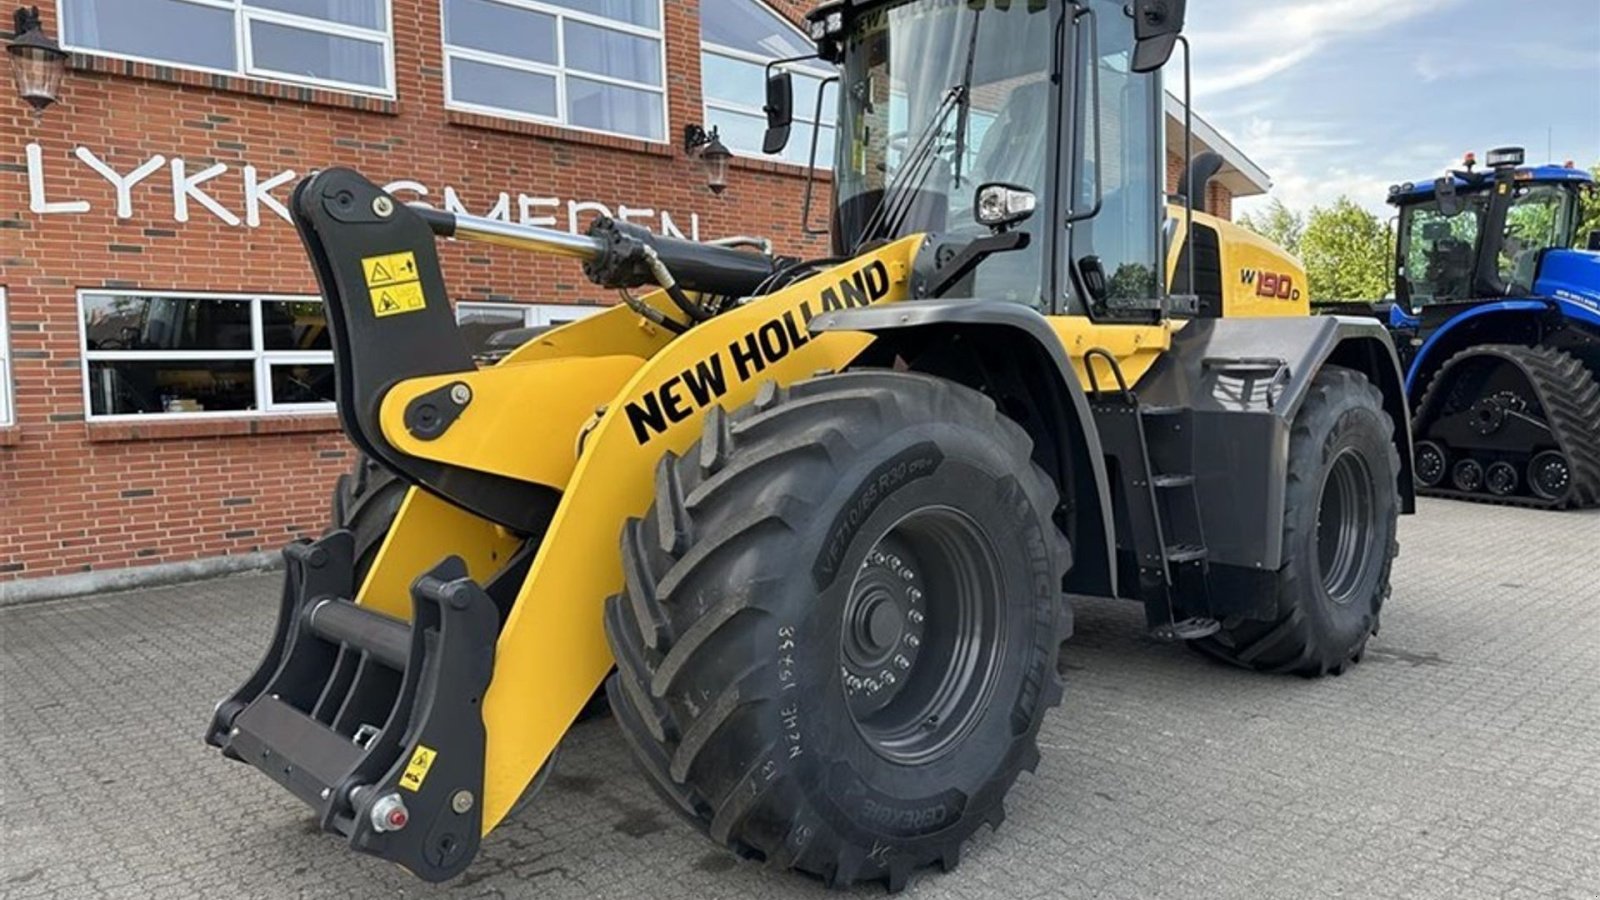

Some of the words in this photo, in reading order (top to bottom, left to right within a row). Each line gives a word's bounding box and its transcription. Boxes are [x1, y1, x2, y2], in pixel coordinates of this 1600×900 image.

[27, 144, 700, 241] LYKKSMEDEN
[625, 353, 727, 445] NEW
[729, 260, 889, 381] HOLLAND
